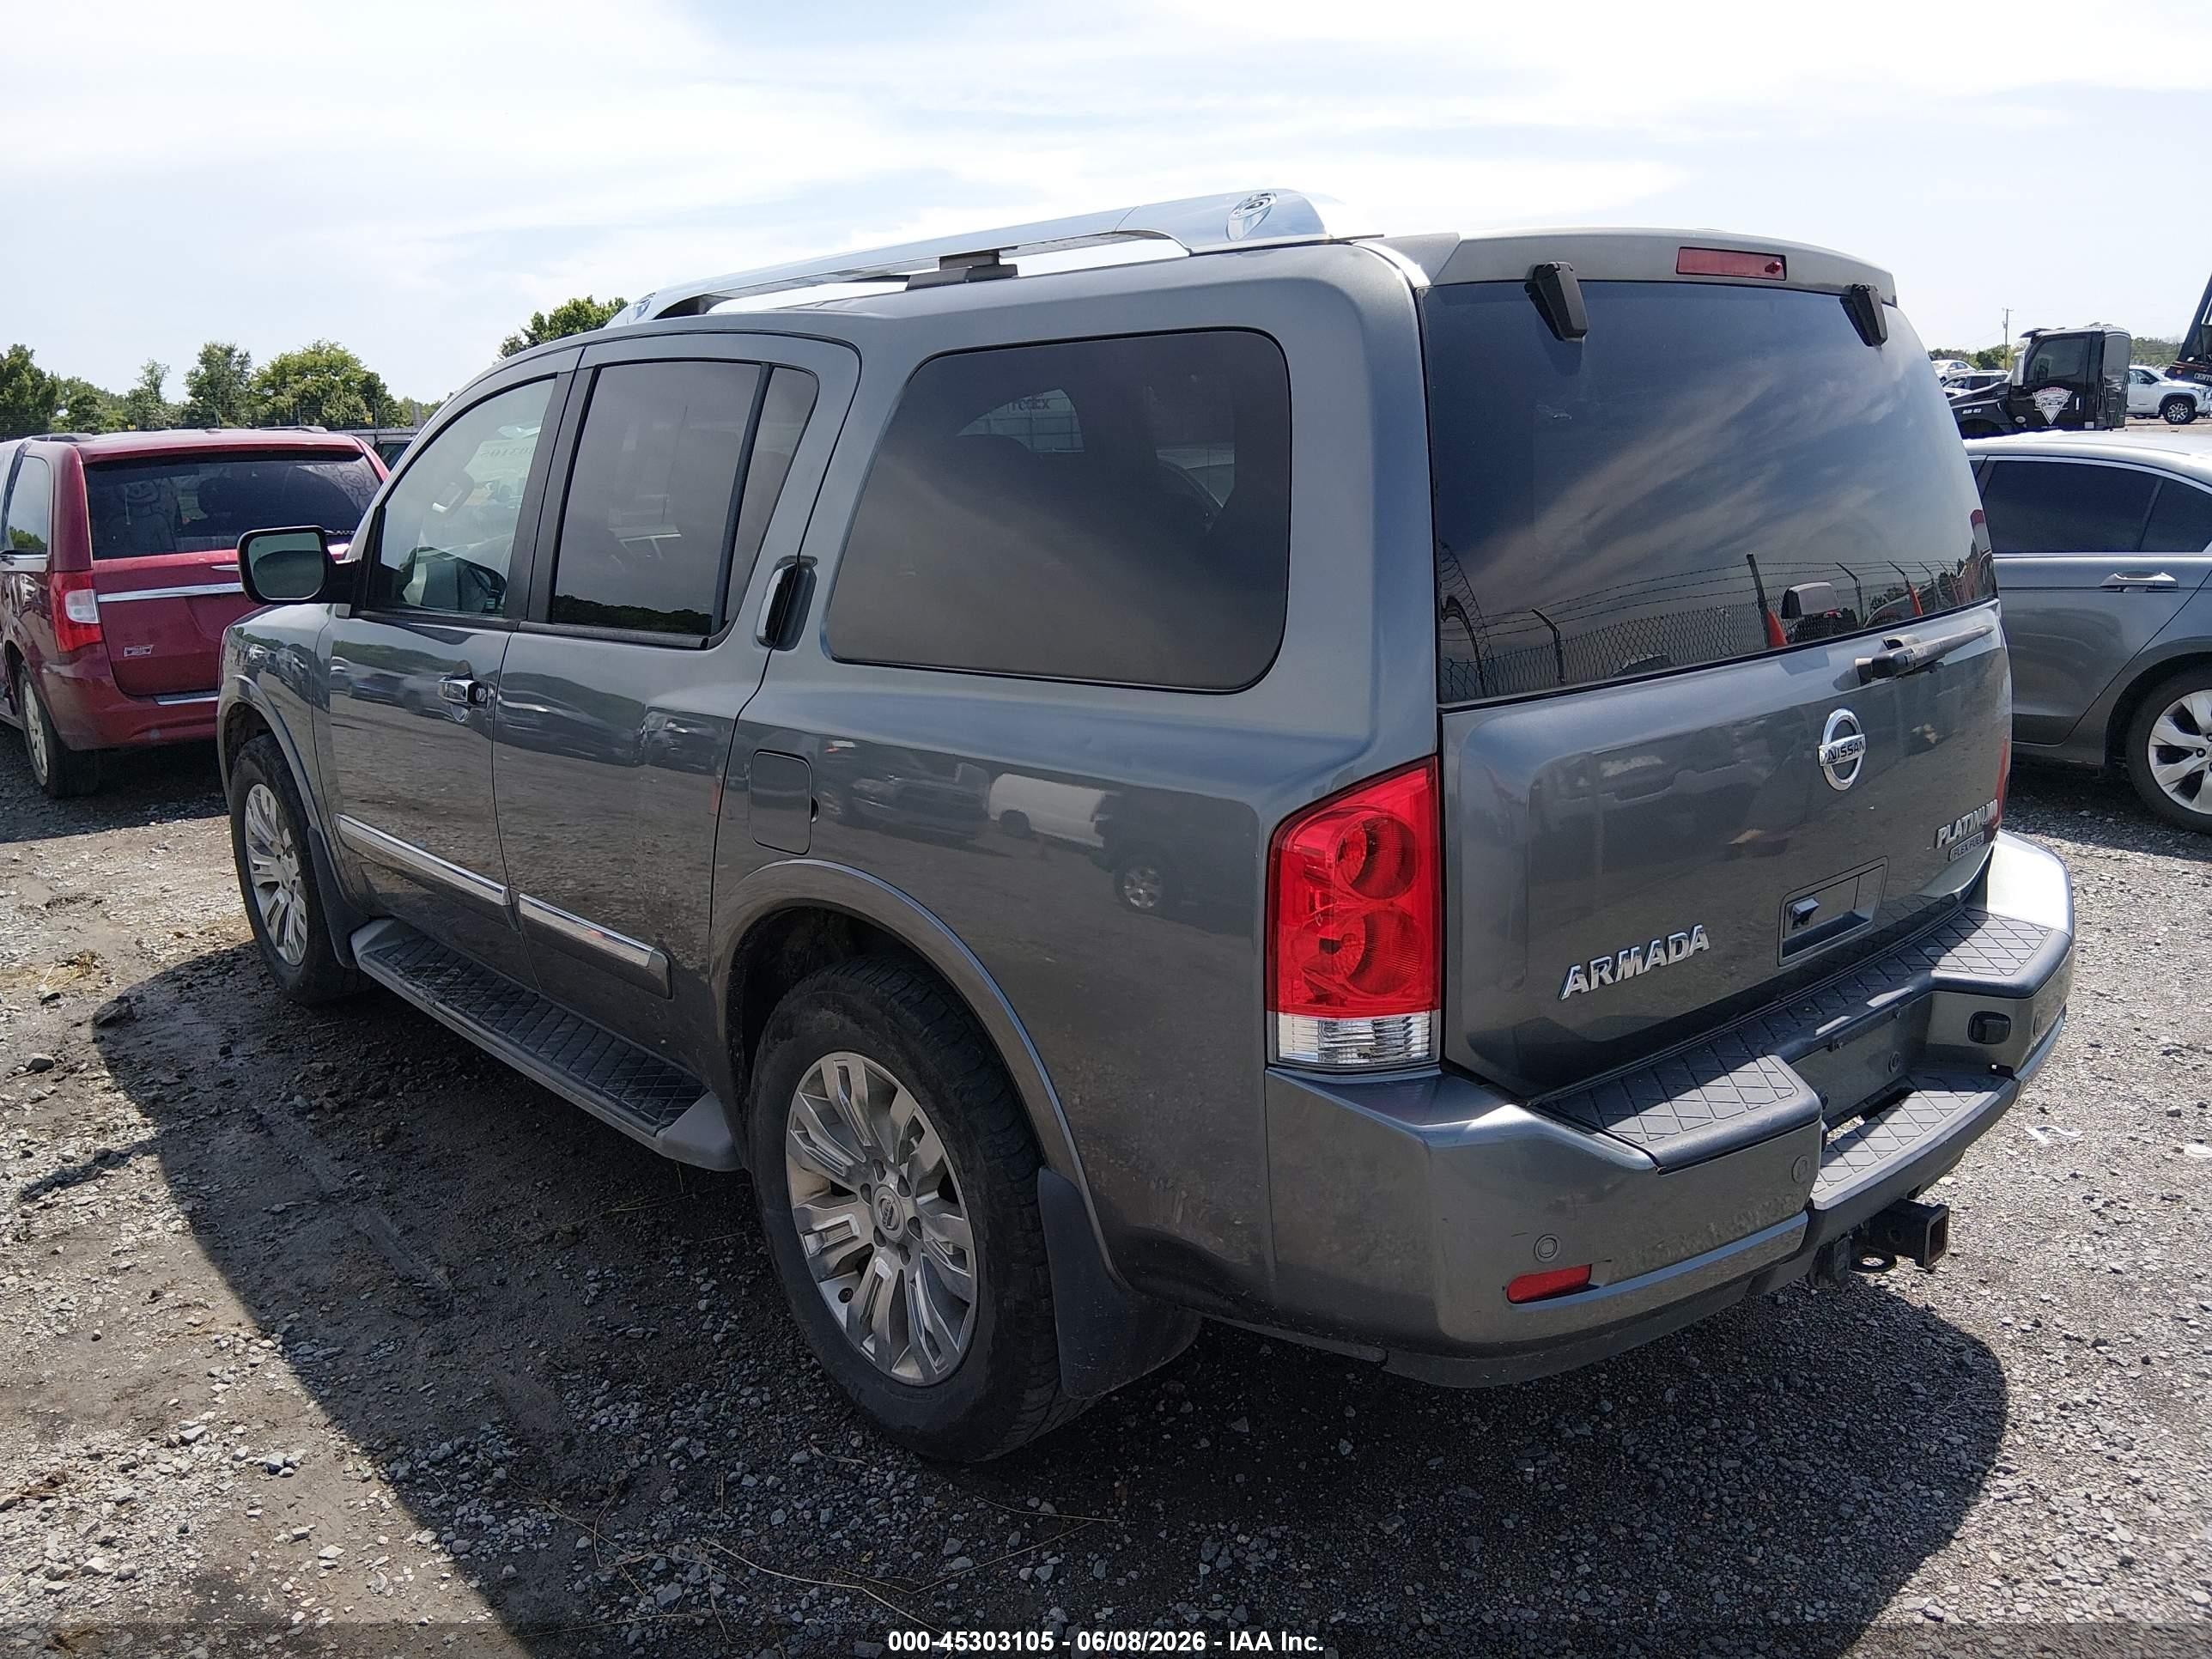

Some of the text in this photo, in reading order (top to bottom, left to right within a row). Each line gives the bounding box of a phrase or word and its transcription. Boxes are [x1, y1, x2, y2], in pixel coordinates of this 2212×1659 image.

[1827, 739, 1865, 763] NISSAN
[1936, 799, 1997, 848] PLATINUM
[1559, 923, 1711, 1001] ARMADA
